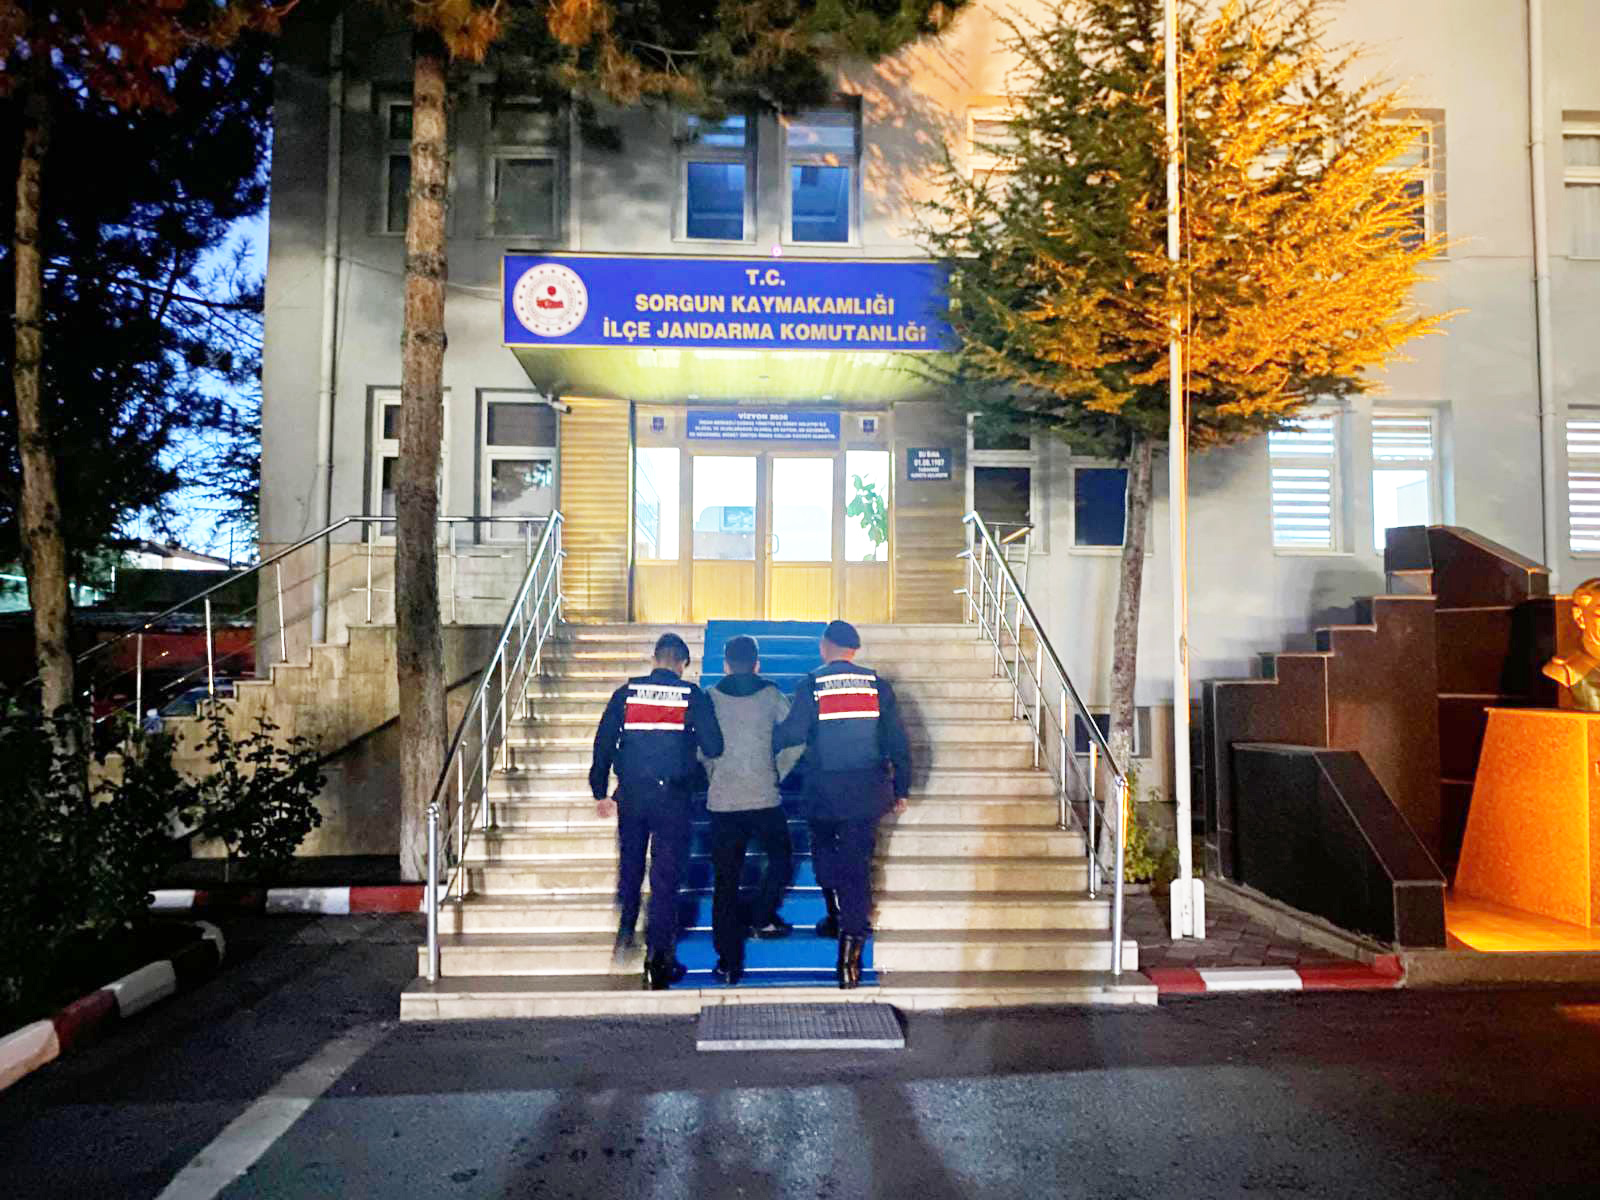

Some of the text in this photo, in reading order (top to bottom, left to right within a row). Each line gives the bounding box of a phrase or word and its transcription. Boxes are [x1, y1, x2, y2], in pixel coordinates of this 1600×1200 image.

[745, 269, 786, 286] T.C.
[635, 293, 895, 315] SORGUN KAYMAKAMLIĞI
[603, 316, 927, 342] İLÇE JANDARMA KOMUTANLIĞI
